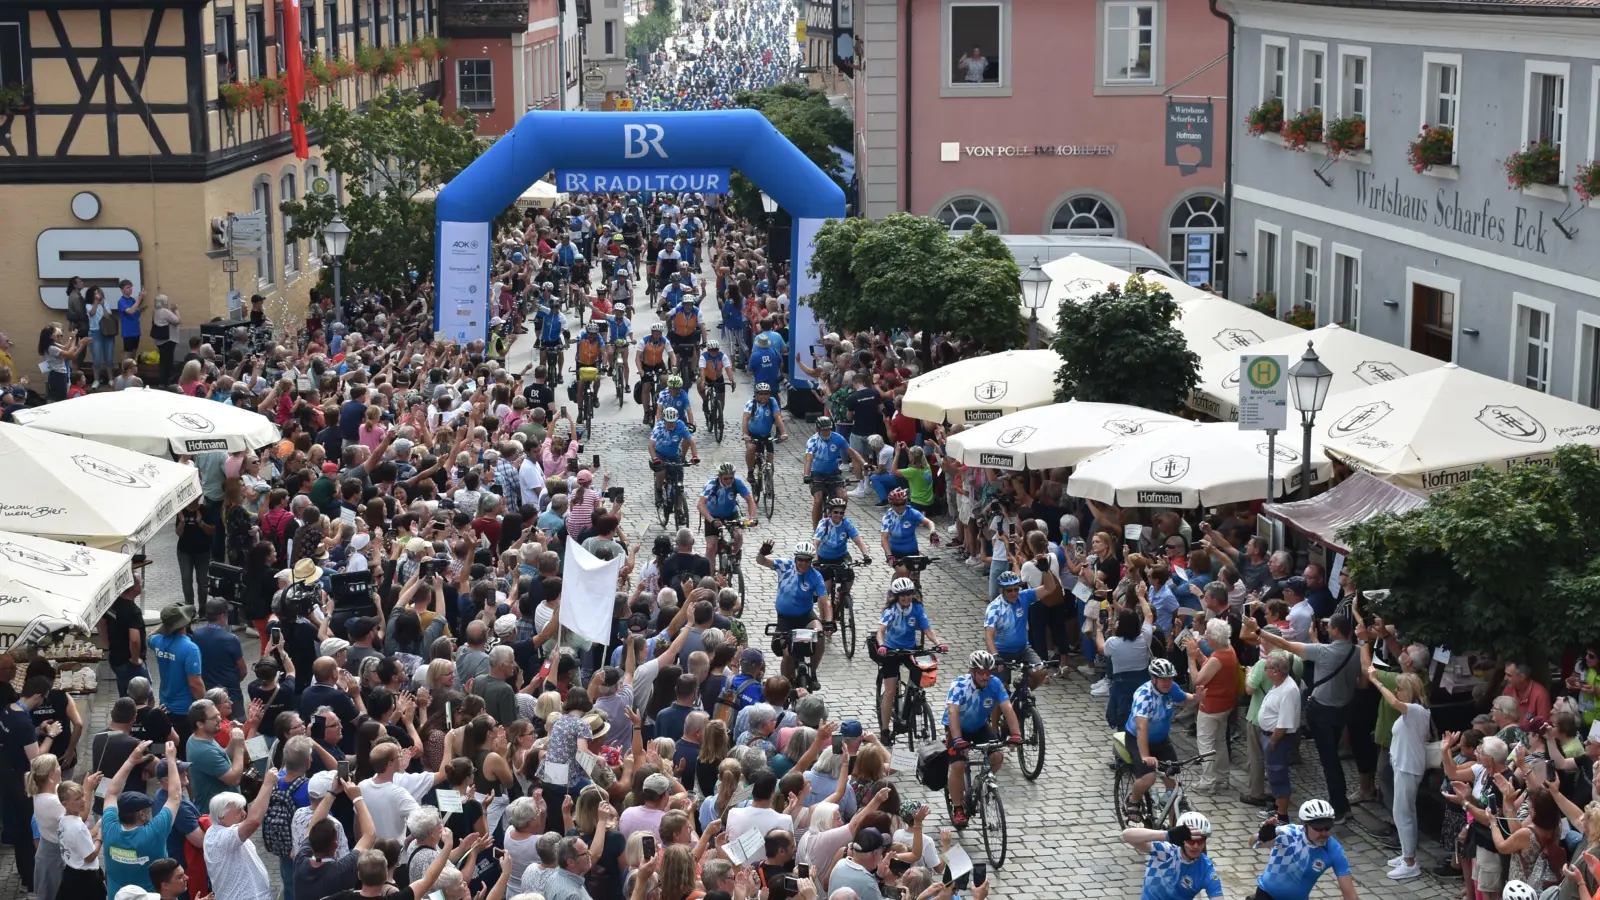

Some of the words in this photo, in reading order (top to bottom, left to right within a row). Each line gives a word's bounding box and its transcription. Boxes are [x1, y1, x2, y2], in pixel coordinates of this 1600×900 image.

[1175, 105, 1205, 114] Wirtshaus
[1170, 115, 1195, 123] Scharfes
[624, 124, 669, 159] BR
[1176, 131, 1202, 140] Hofmann
[965, 146, 995, 157] VON
[997, 145, 1031, 156] POLL
[1034, 144, 1116, 157] IMMOBILIEN
[565, 173, 590, 192] BR
[594, 174, 720, 192] RADLTOUR
[1356, 169, 1428, 223] Wirtshaus
[1434, 188, 1505, 243] Scharfes
[1512, 206, 1548, 255] Eck
[453, 240, 470, 248] AOK
[1192, 390, 1220, 415] Hofmann
[967, 410, 1002, 420] Hofmann
[187, 440, 227, 451] Hofmann
[982, 454, 1012, 466] Hofmann
[1421, 469, 1472, 489] Hofma
[1139, 491, 1180, 503] Hofmann
[154, 647, 176, 661] Team
